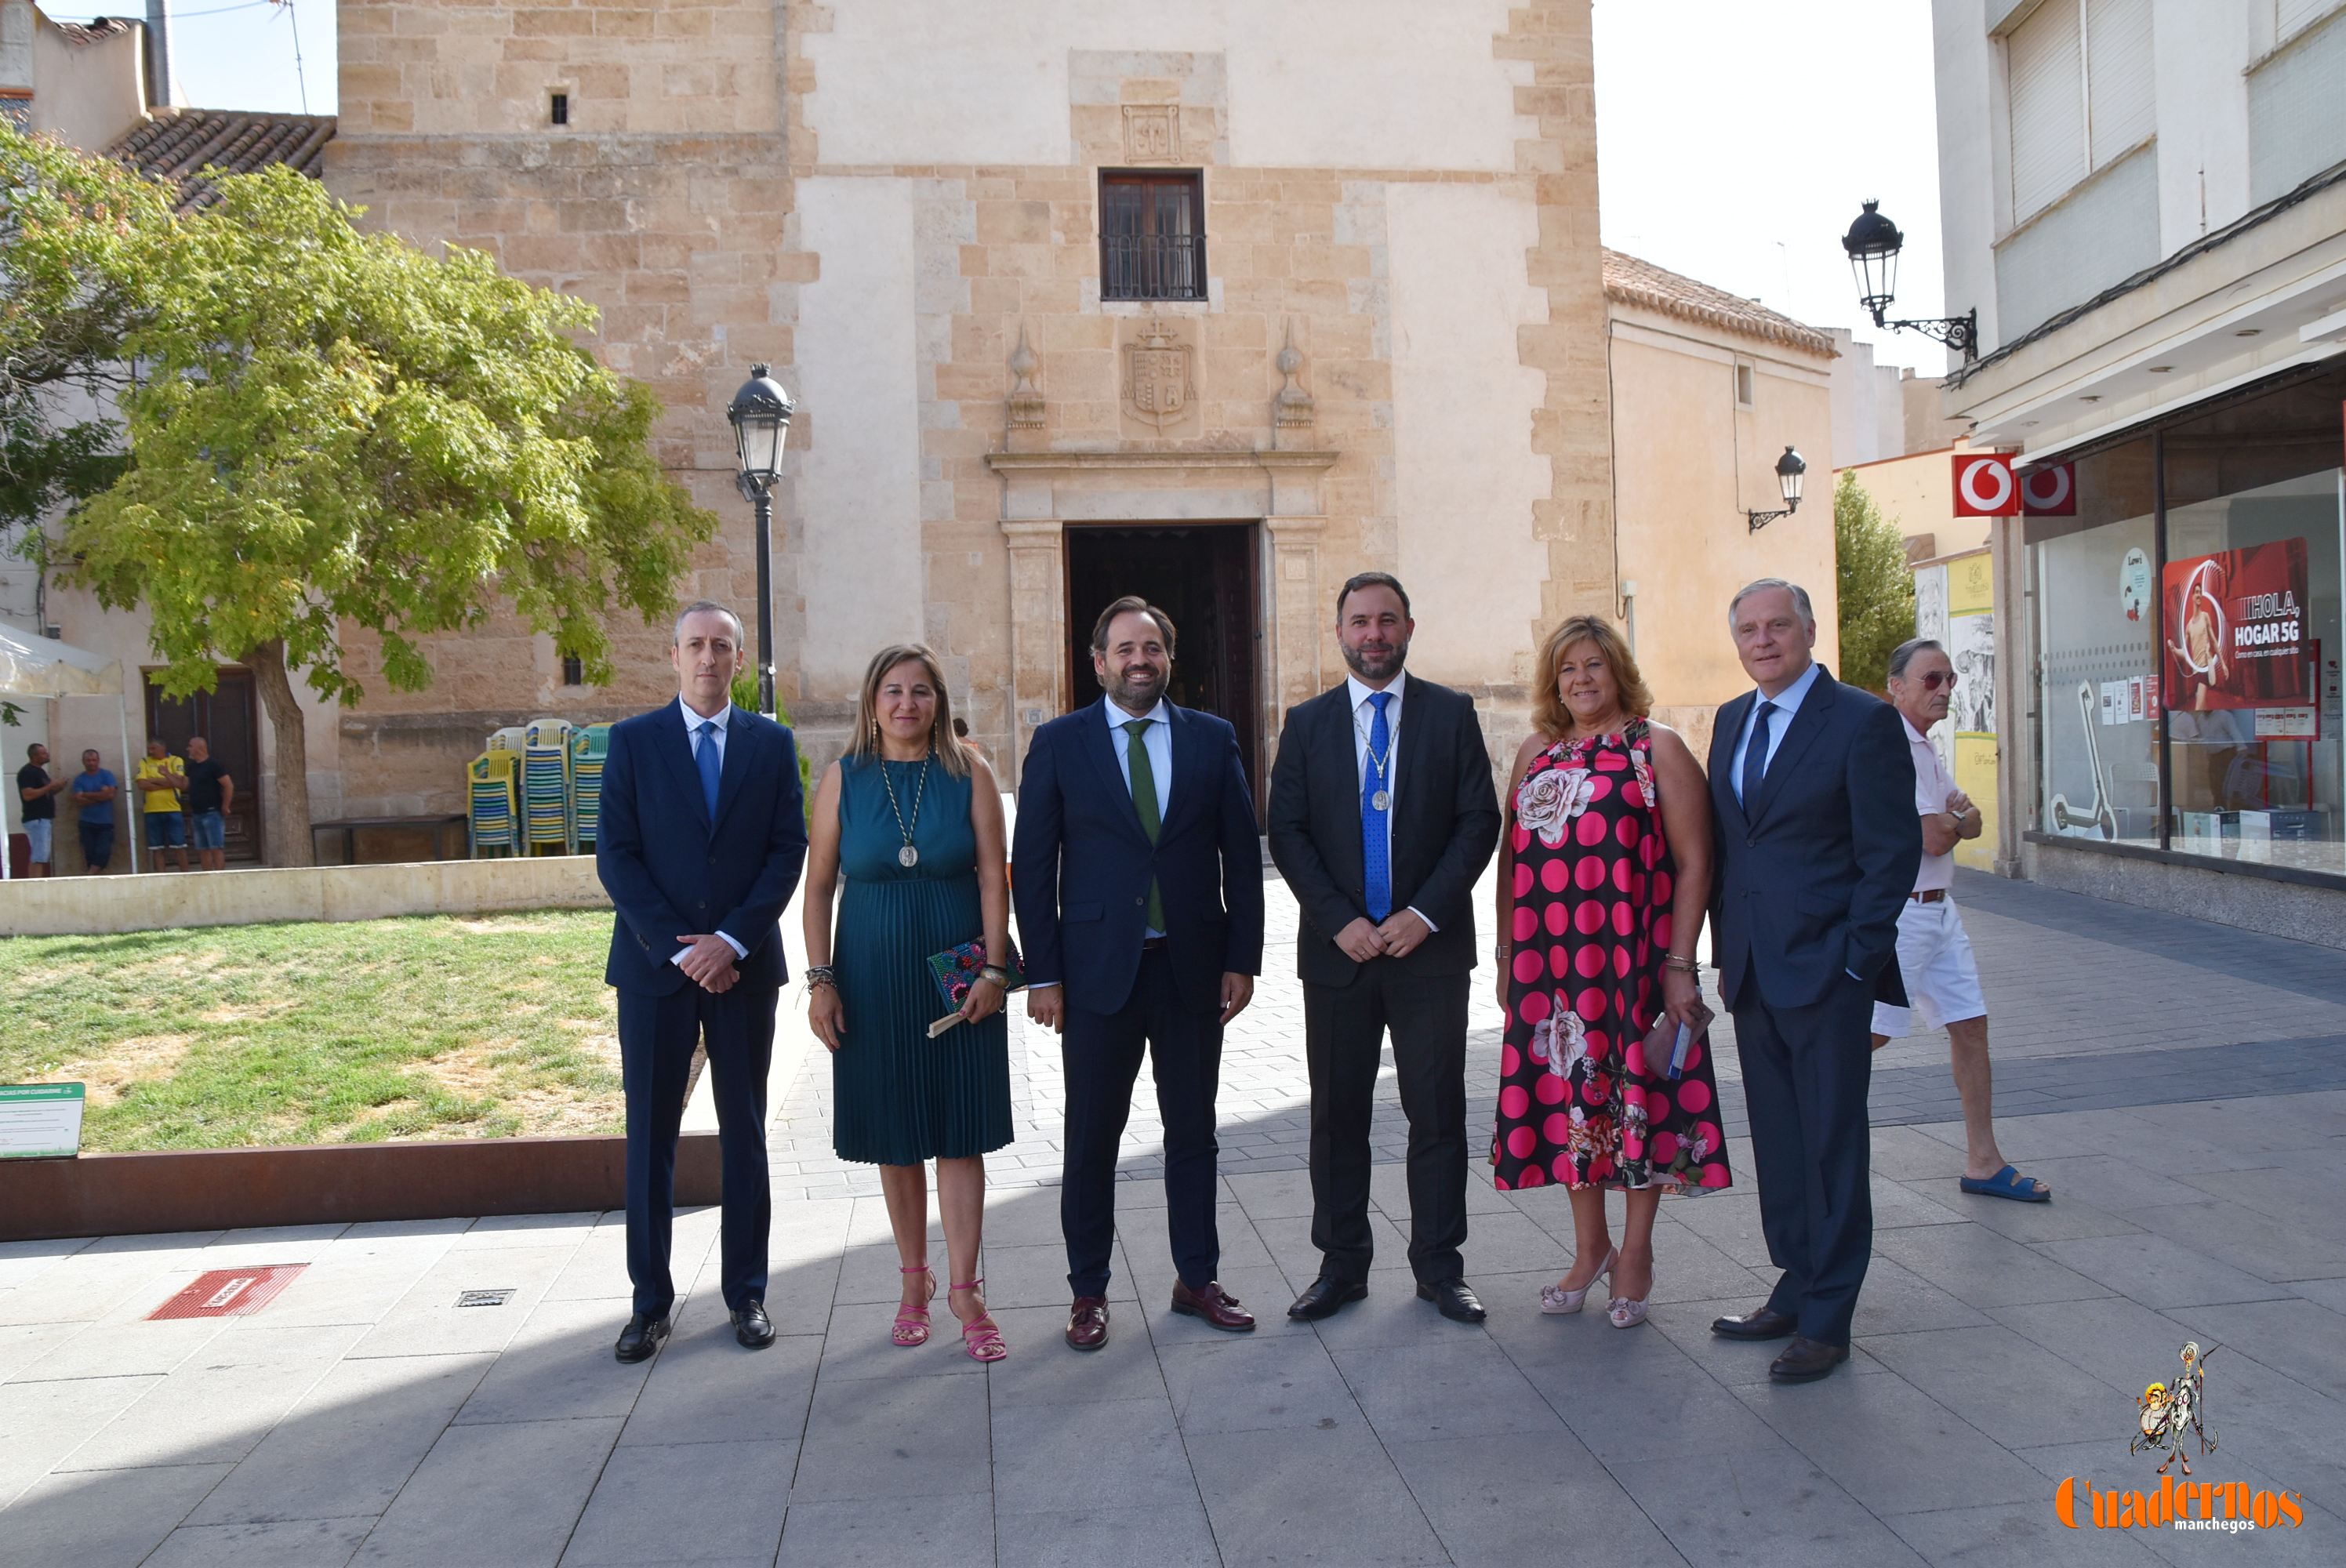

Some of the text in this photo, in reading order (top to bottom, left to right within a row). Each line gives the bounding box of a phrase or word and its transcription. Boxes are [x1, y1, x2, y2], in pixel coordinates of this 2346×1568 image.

[2128, 554, 2142, 565] Lowi
[2235, 620, 2299, 647] HOGAR 5G
